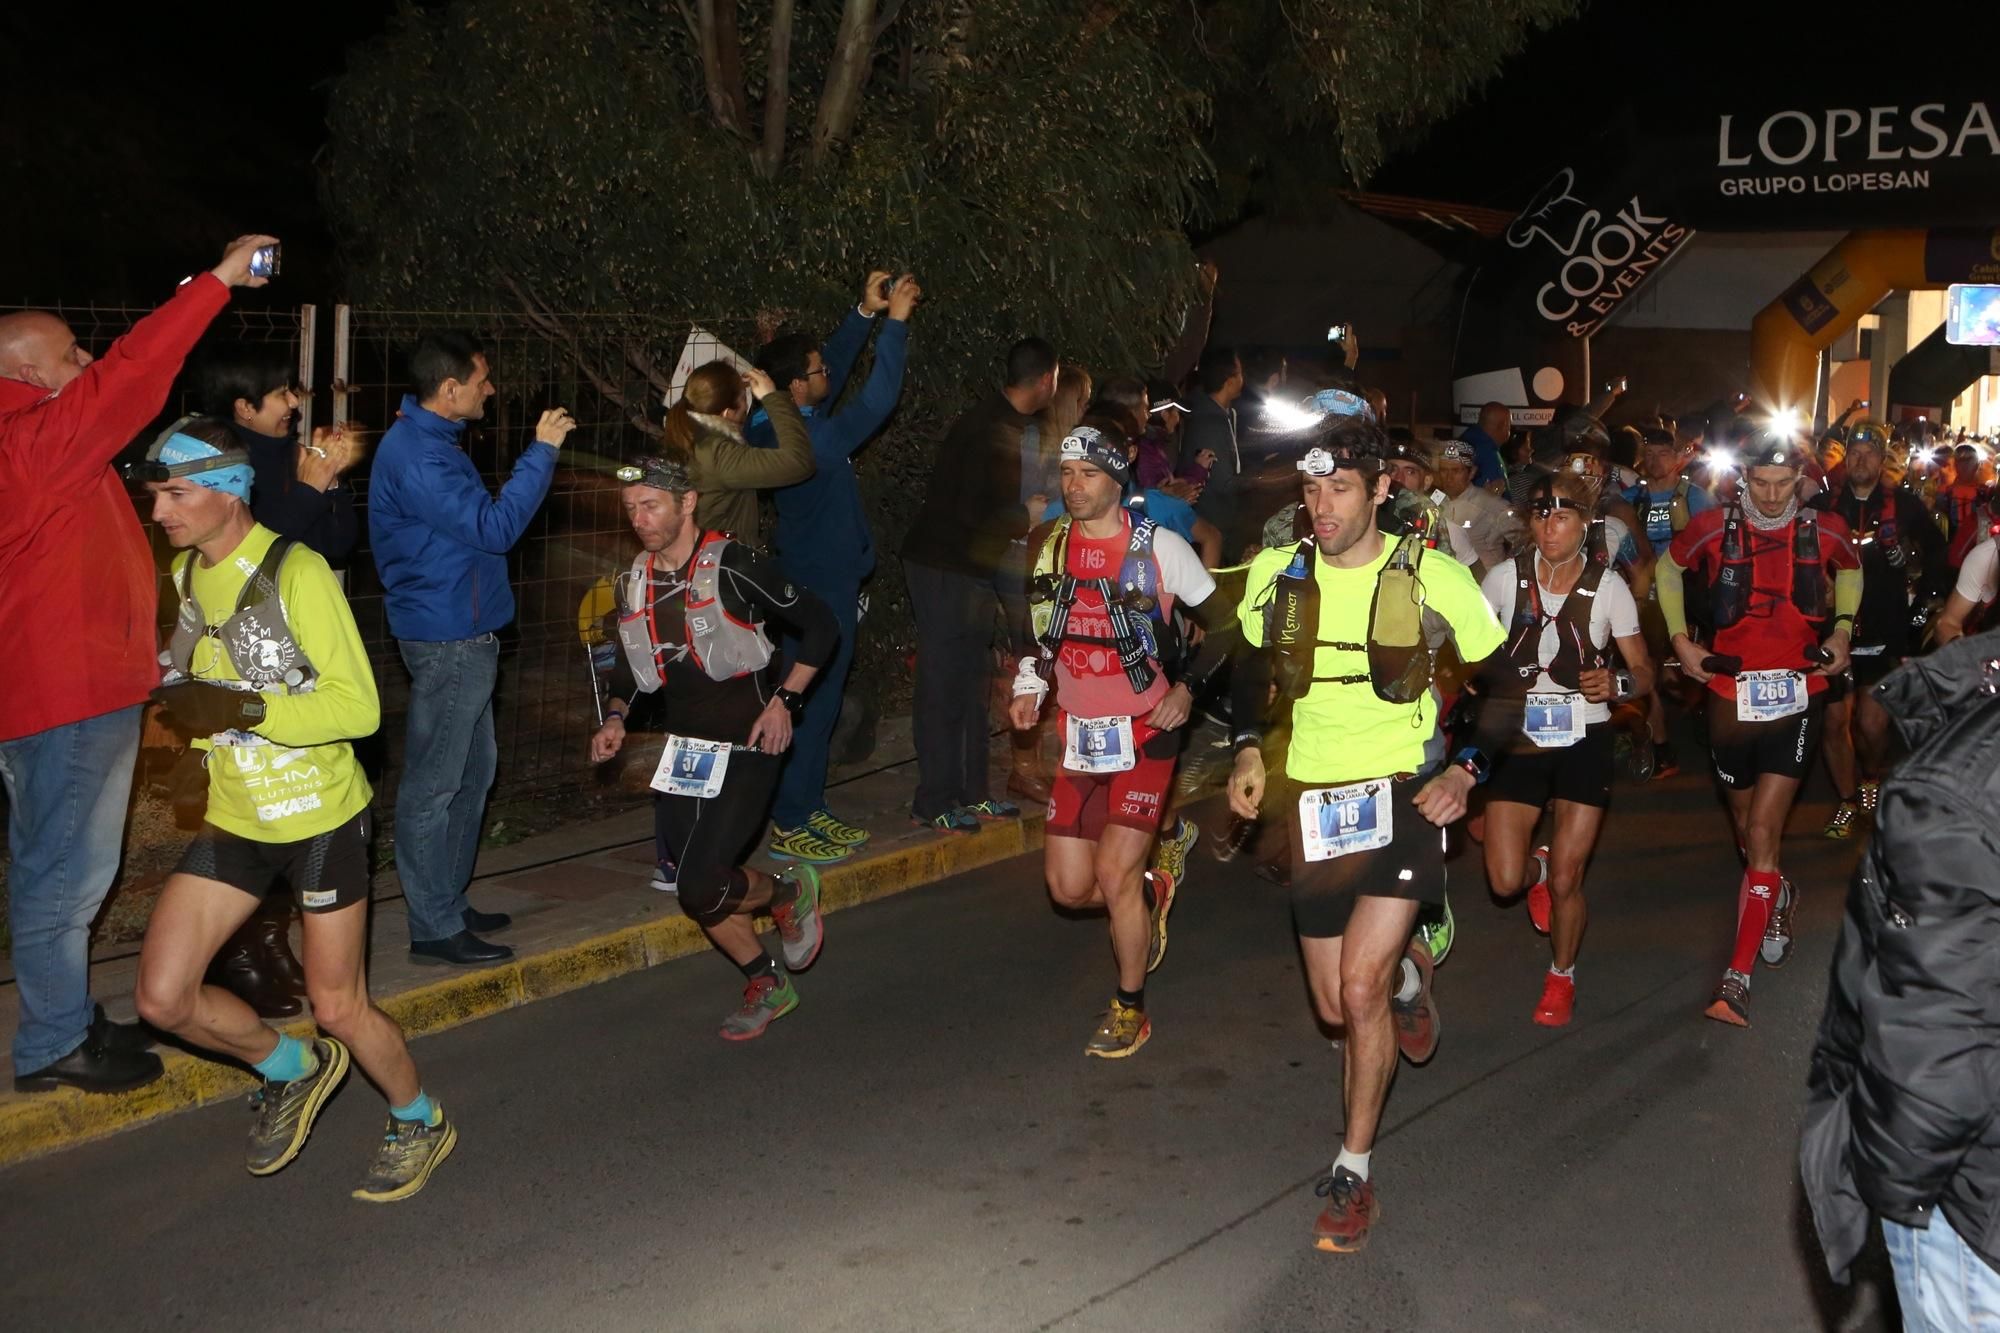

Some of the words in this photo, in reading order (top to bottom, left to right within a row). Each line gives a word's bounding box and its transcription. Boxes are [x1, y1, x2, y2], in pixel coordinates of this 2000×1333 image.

[1720, 176, 1806, 196] GRUPO
[1813, 170, 1929, 193] LOPESAN
[1536, 195, 1668, 321] COOK
[1567, 319, 1597, 337] &
[1589, 224, 1686, 314] EVENTS
[1523, 412, 1552, 421] GROUP
[1757, 681, 1787, 701] 266
[1543, 708, 1553, 726] 1
[1087, 730, 1107, 751] 35
[682, 753, 702, 773] 57
[1336, 802, 1360, 827] 16
